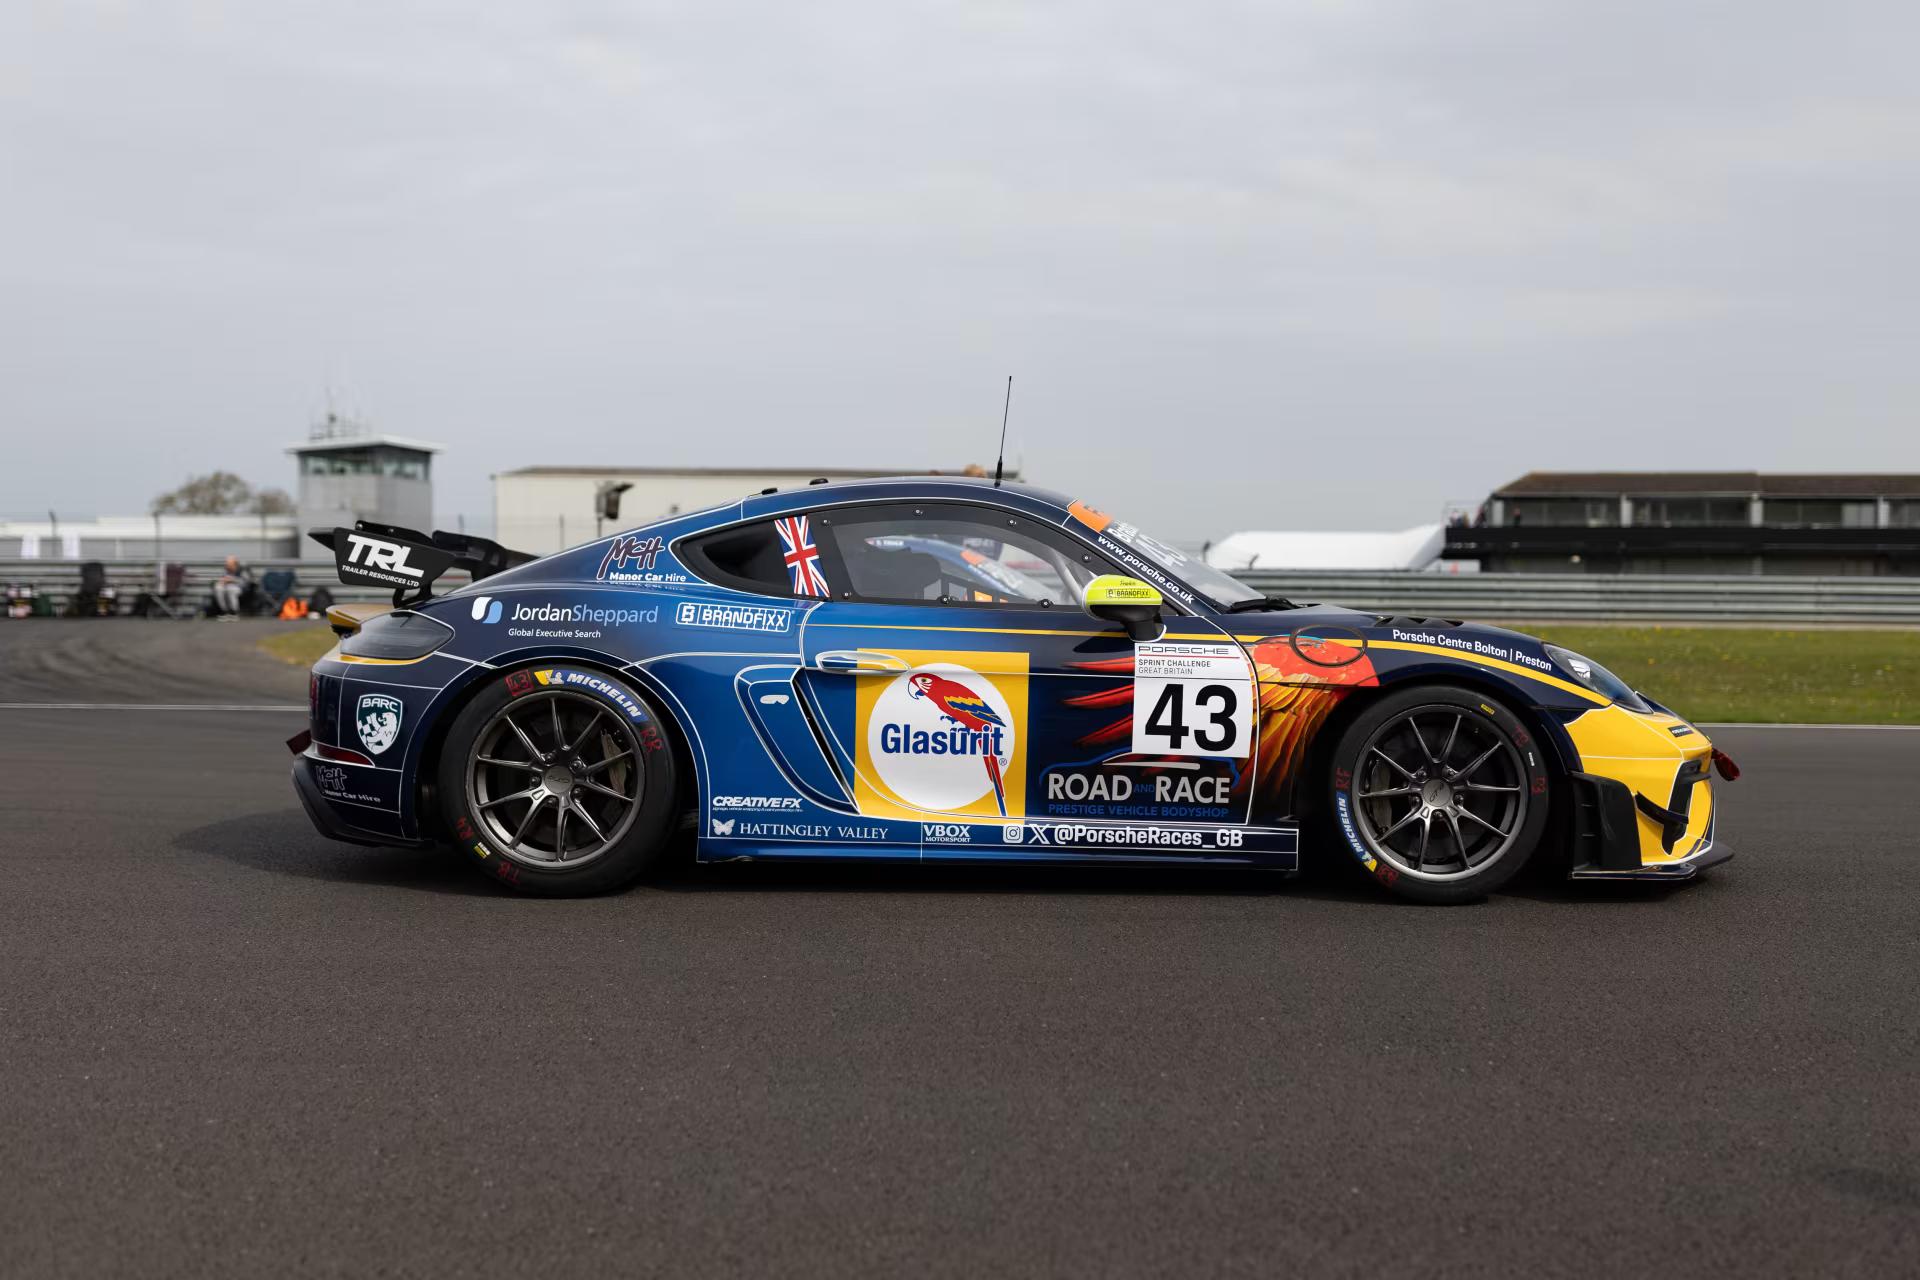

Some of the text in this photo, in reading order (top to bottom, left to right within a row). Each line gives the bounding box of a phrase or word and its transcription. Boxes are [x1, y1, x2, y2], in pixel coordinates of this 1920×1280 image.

[347, 533, 425, 578] TRL
[341, 564, 368, 576] TRAILER
[368, 571, 406, 585] RESOURCES
[609, 572, 687, 582] Manor Car Hire
[1098, 535, 1196, 605] www.porsche.co.uk
[511, 603, 659, 627] JordanSheppard
[702, 608, 787, 628] BRANDFIXX
[508, 628, 602, 638] Global Executive Search
[1138, 646, 1230, 655] PORSCHE
[1392, 629, 1436, 644] Porsche
[1437, 634, 1473, 650] Centre
[1474, 641, 1508, 658] Bolton
[1515, 650, 1552, 671] Preston
[1166, 660, 1212, 668] CHALLENGE
[361, 698, 399, 712] BARC
[566, 673, 642, 718] MICHELIN
[1144, 683, 1238, 752] 43
[358, 793, 382, 803] Hire
[1048, 773, 1230, 804] ROAD AND RACE
[1048, 804, 1230, 818] PRESTIGE VEHICLE BODYSHOP
[739, 823, 889, 840] HATTINGLEY VALLEY
[923, 824, 971, 838] VBOX
[1338, 797, 1364, 853] MICHELIN
[1054, 824, 1244, 849] @PorscheRaces_GB
